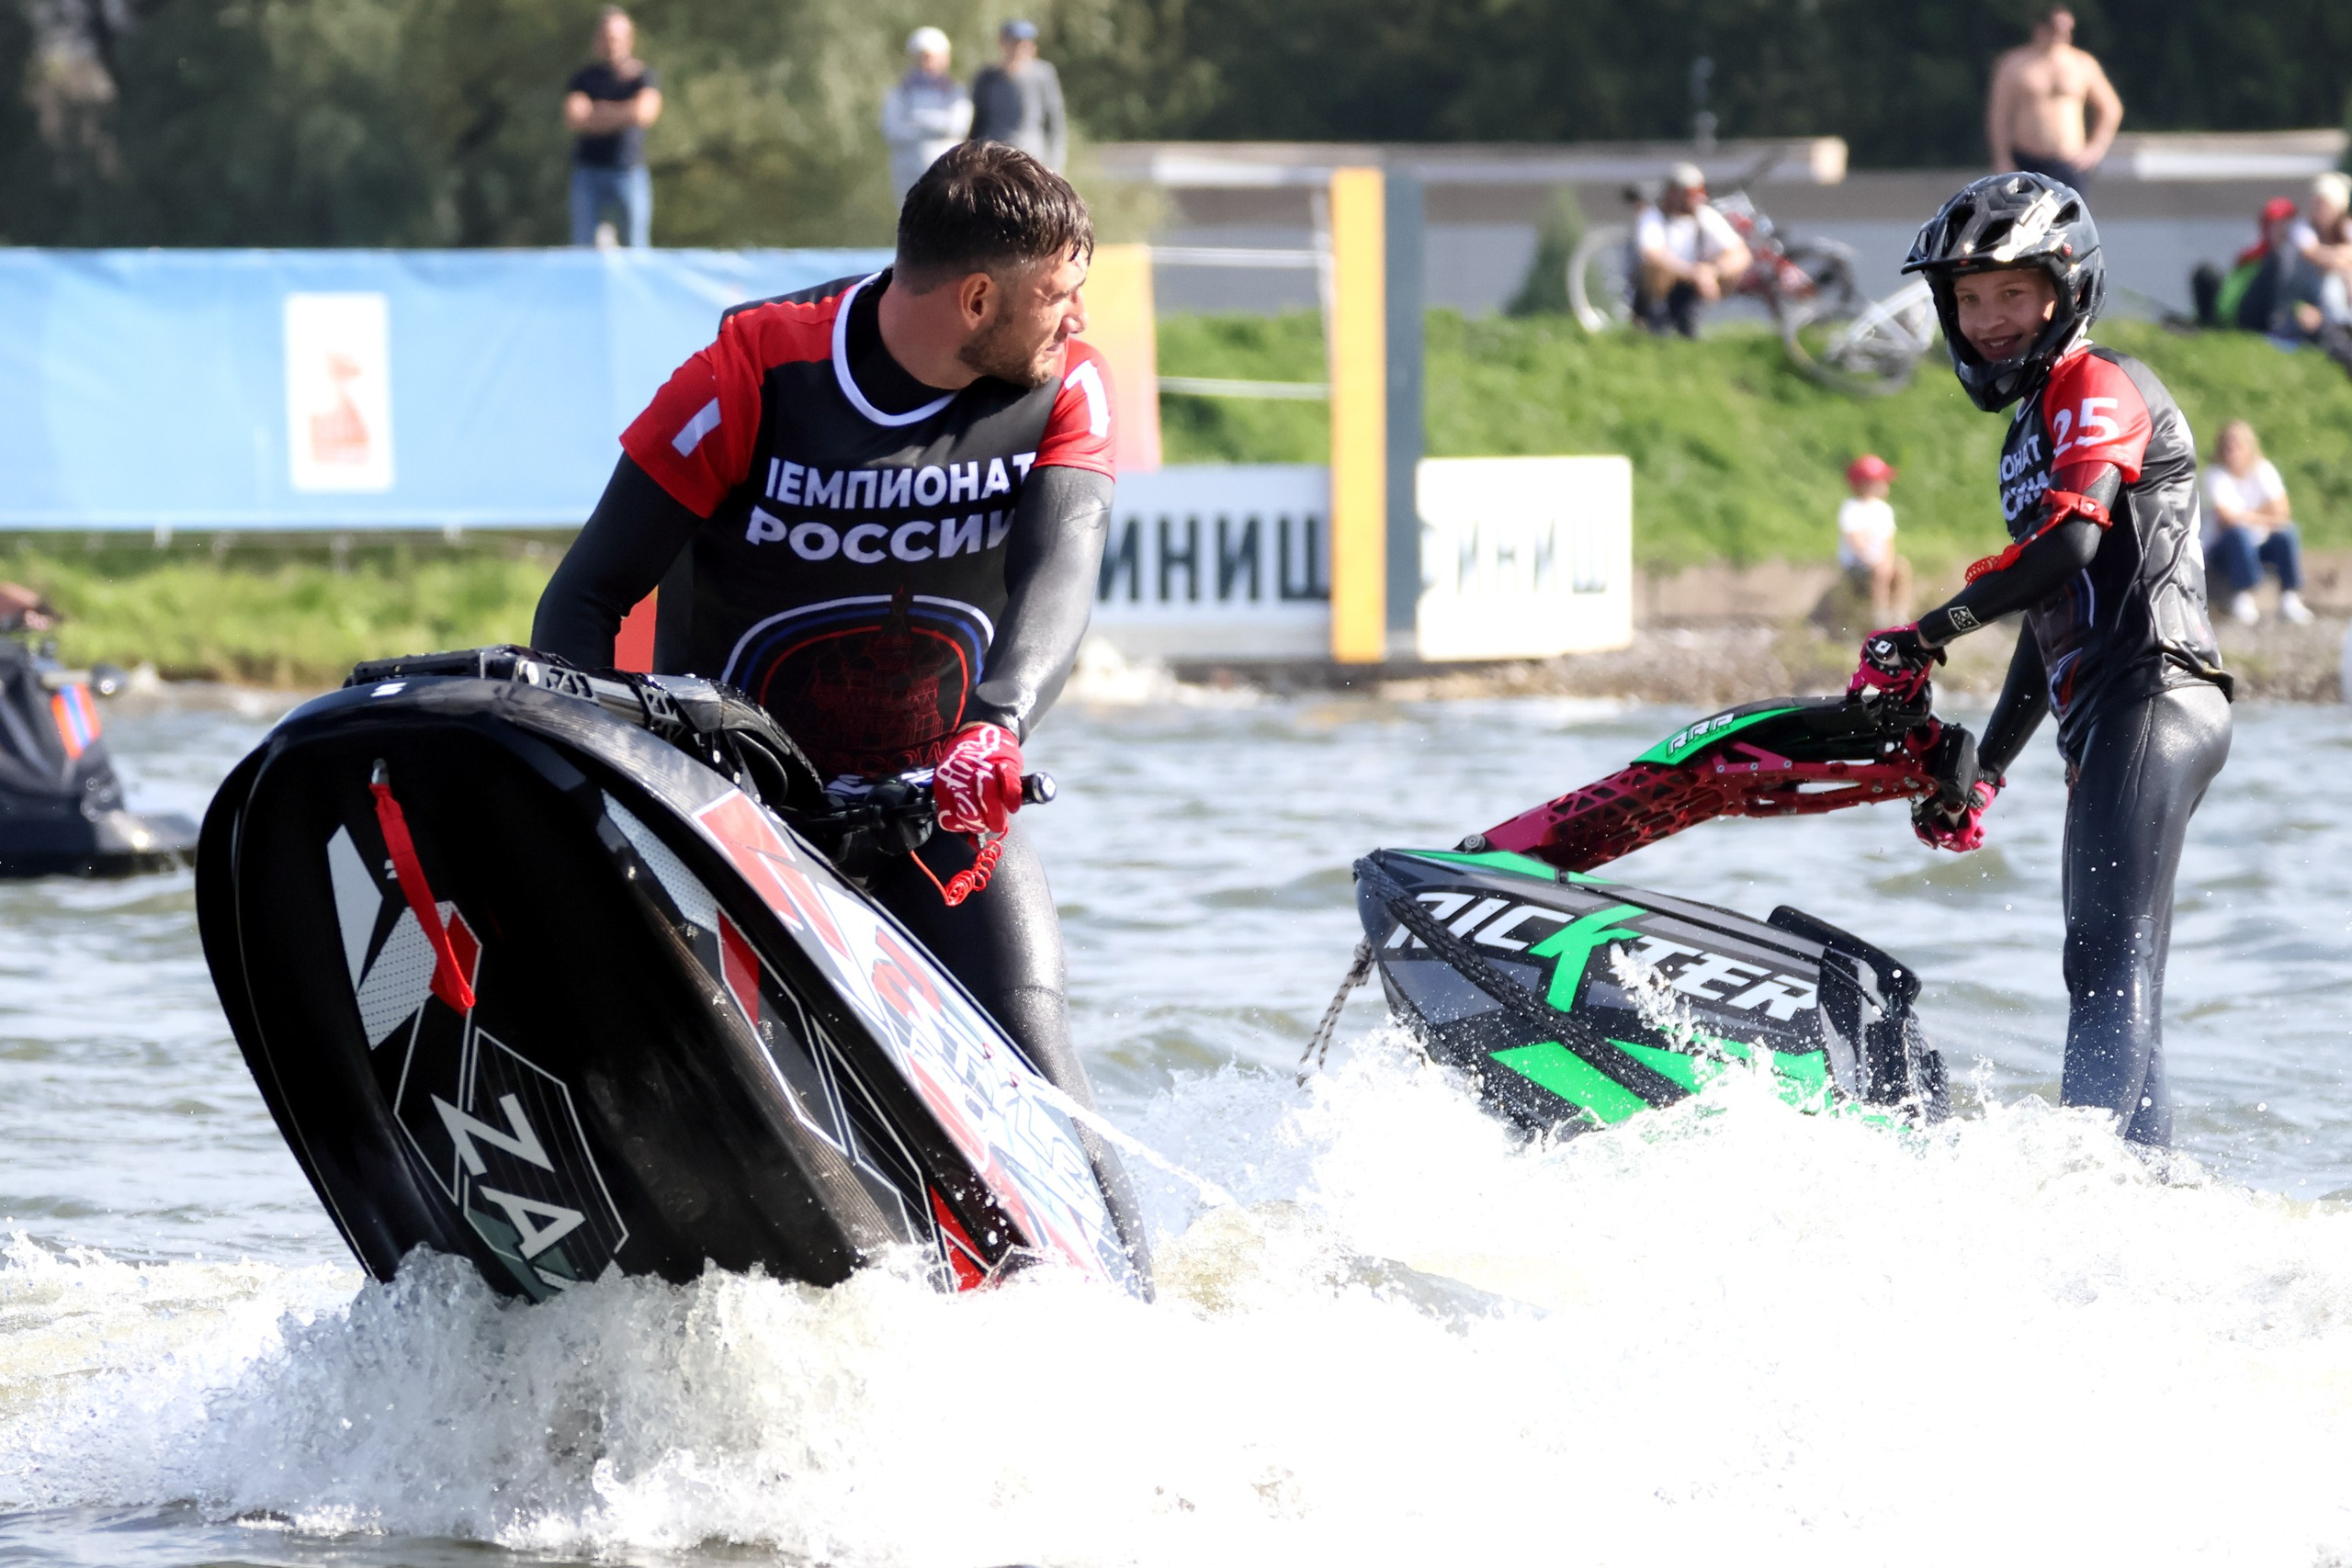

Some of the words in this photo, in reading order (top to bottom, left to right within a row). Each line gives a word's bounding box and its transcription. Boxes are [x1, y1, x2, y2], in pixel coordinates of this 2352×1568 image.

[2052, 397, 2120, 452] 25
[1999, 434, 2041, 485] ОНАТ
[745, 505, 1015, 564] РОССИИ
[1667, 713, 1735, 757] RRP
[431, 1093, 597, 1289] ZA
